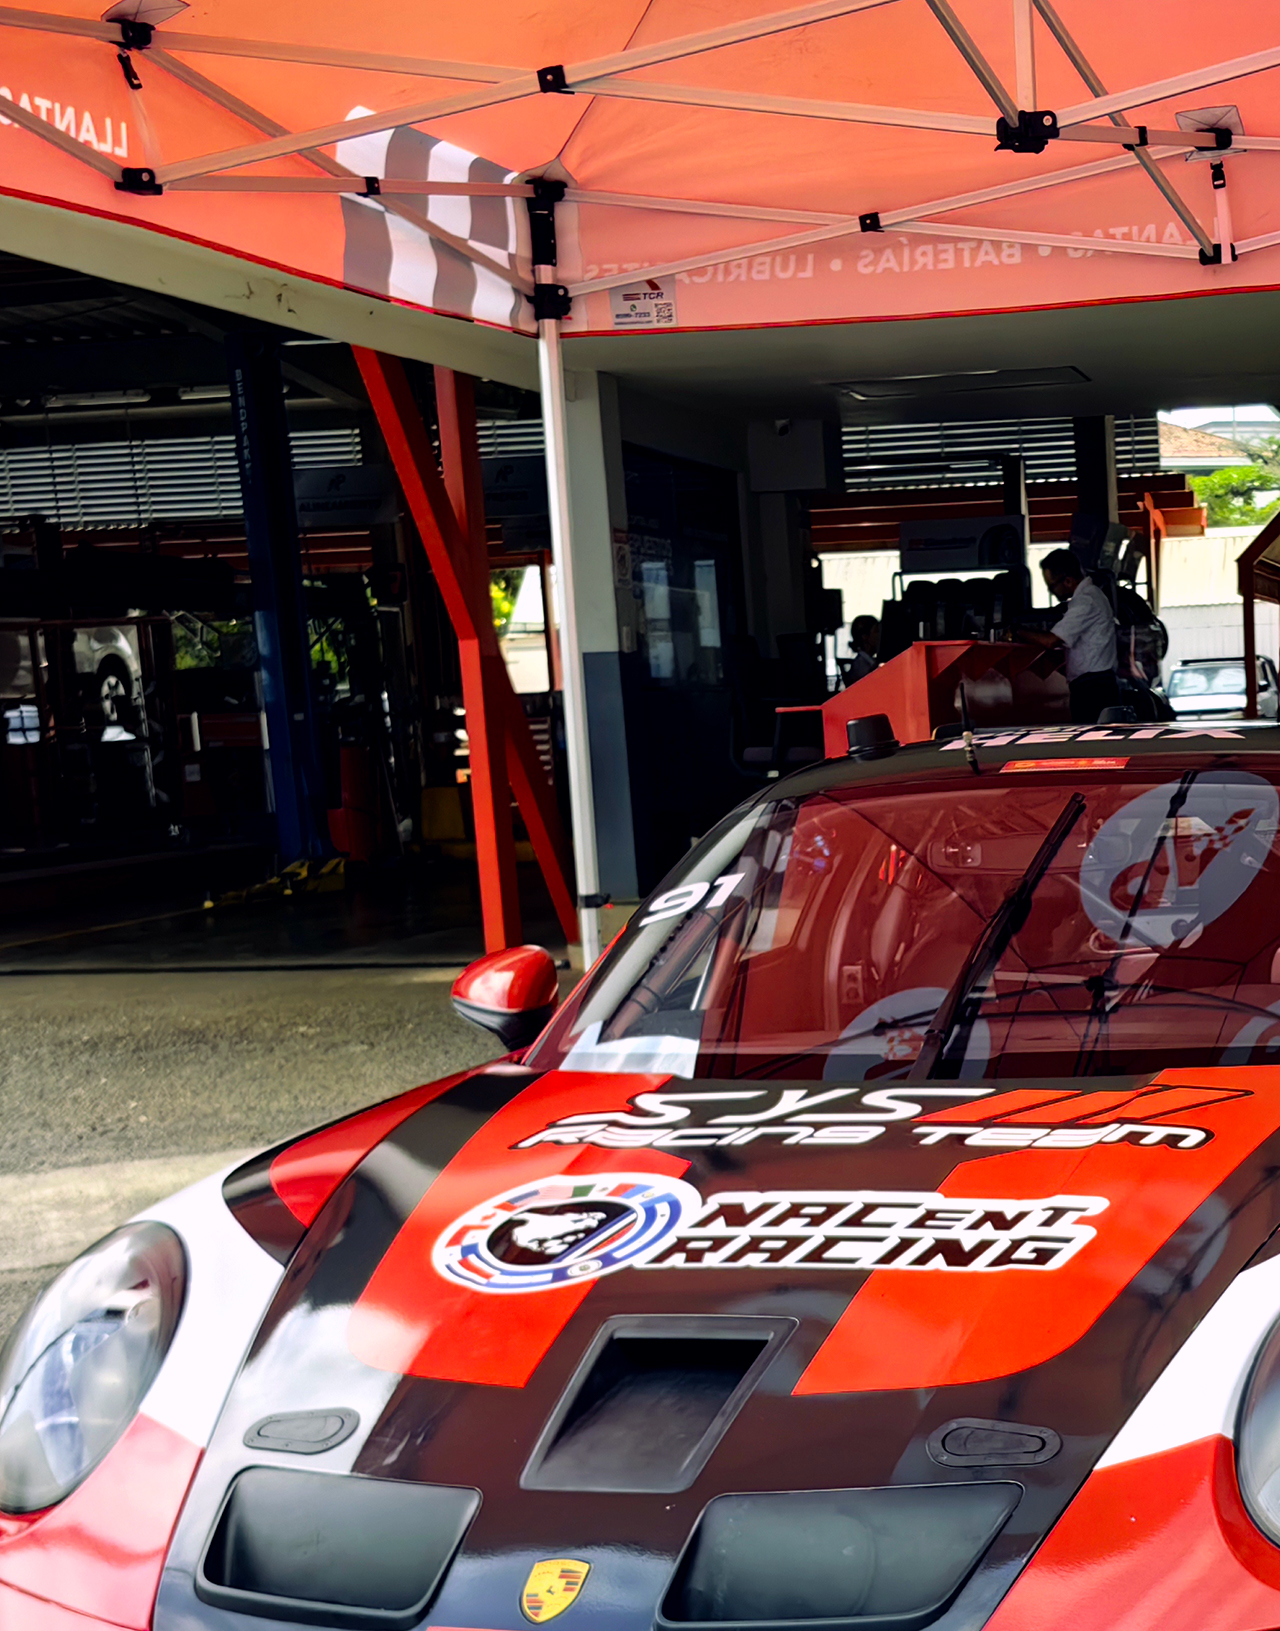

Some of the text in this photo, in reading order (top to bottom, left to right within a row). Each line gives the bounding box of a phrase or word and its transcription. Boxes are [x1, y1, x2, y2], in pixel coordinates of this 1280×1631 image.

[939, 728, 1226, 751] HELIX
[639, 873, 746, 927] 91
[644, 1234, 1077, 1268] RACING
